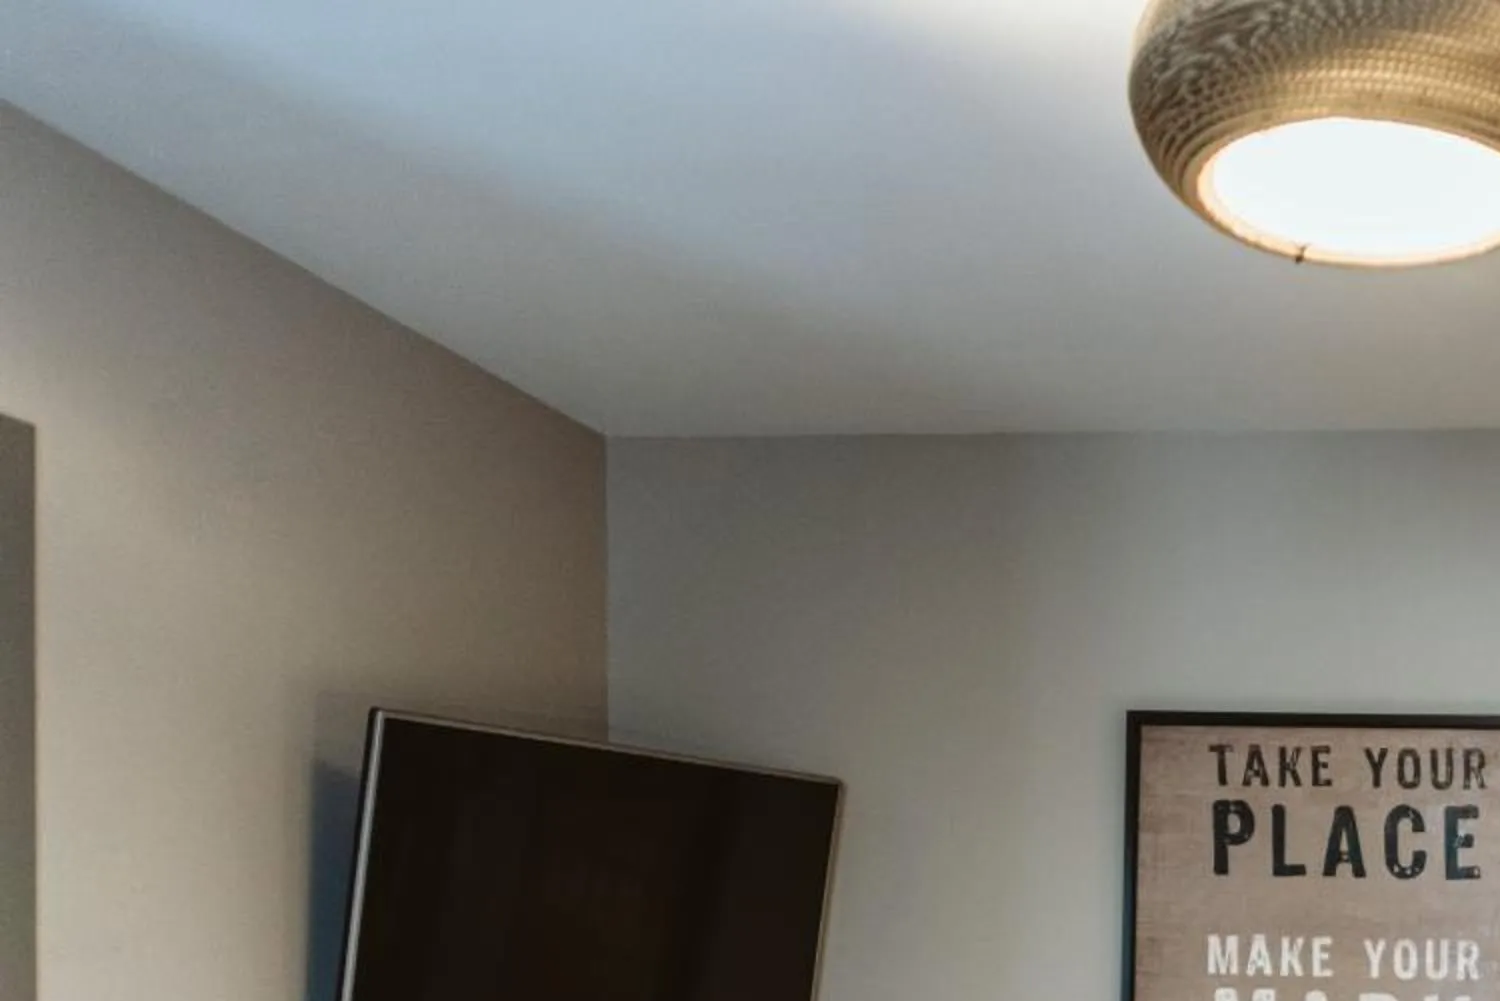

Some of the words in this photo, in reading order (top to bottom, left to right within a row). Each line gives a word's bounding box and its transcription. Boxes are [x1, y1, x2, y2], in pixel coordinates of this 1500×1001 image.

[1209, 744, 1333, 788] TAKE
[1364, 747, 1488, 790] YOUR
[1212, 800, 1481, 880] PLACE
[1206, 934, 1333, 977] MAKE
[1363, 938, 1481, 981] YOUR
